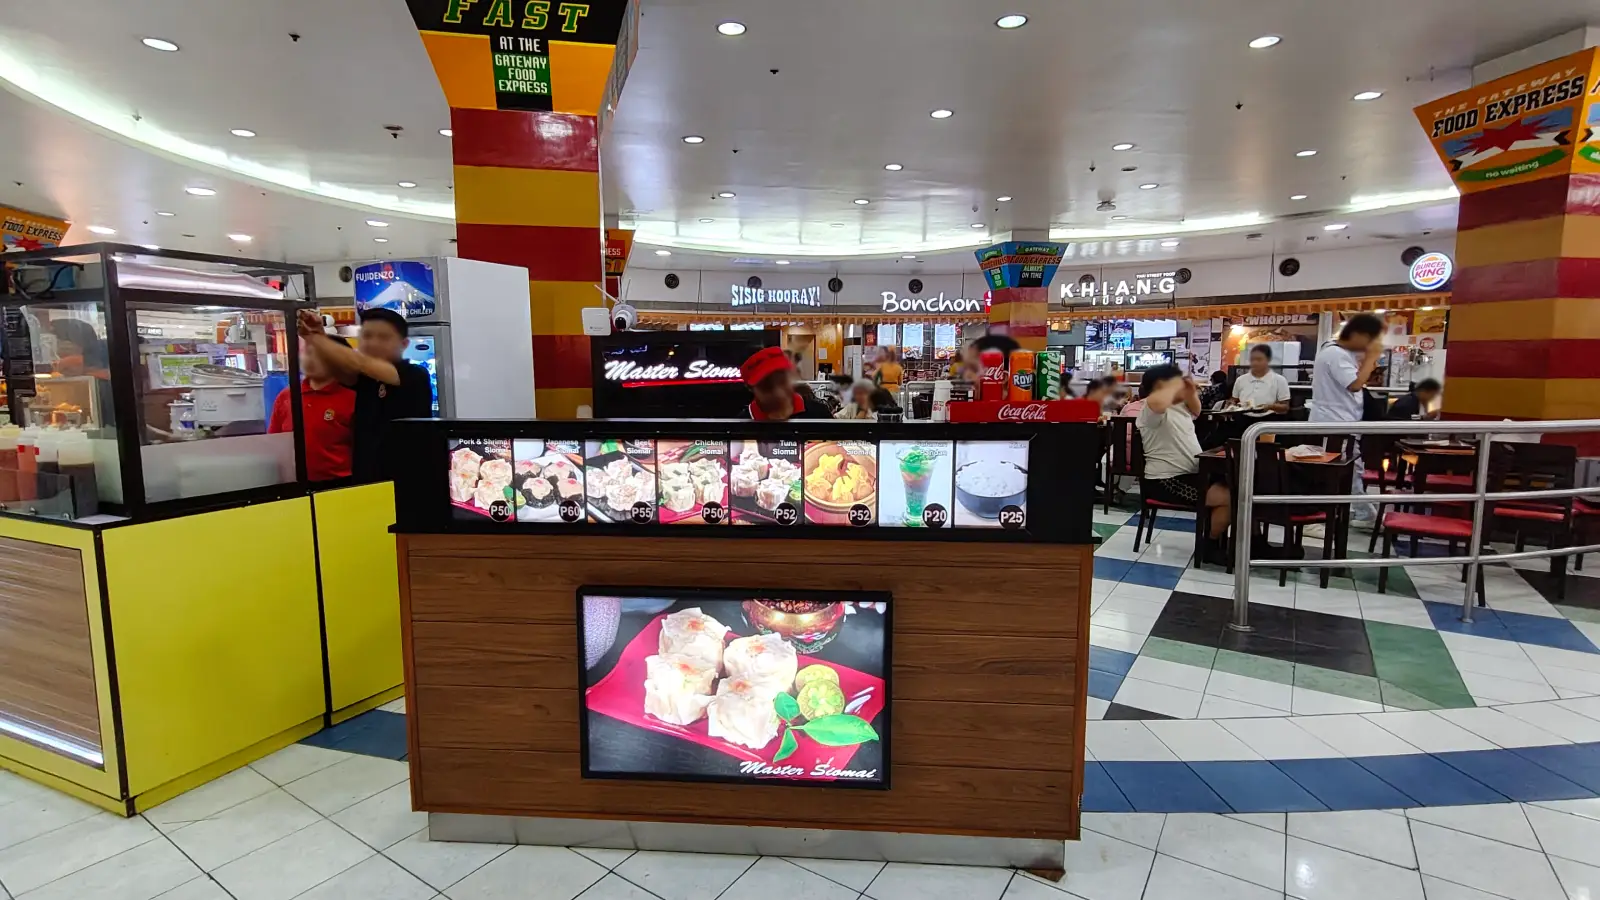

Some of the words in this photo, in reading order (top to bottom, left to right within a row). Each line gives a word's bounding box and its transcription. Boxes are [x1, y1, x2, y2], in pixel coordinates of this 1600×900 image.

[443, 0, 589, 33] FAST
[500, 36, 514, 50] AT
[519, 37, 541, 53] THE
[495, 54, 547, 70] GATEWAY
[508, 67, 537, 81] FOOD
[498, 80, 548, 94] EXPRESS
[1433, 101, 1468, 119] THE
[1477, 67, 1577, 105] GATEWAY
[1431, 108, 1479, 139] FOOD
[1484, 74, 1586, 124] EXPRESS
[1485, 170, 1500, 179] no
[1500, 160, 1540, 177] waiting
[2, 220, 25, 233] FOOD
[26, 225, 63, 241] EXPRESS
[1029, 255, 1062, 265] EXPRESS
[1416, 261, 1447, 271] BURGER
[355, 270, 395, 282] FUJIDENZO
[1414, 268, 1446, 279] KING
[731, 284, 765, 307] SISIG
[767, 285, 821, 307] HOORAY!
[880, 290, 982, 313] Bonchon
[410, 307, 433, 316] CHILLER
[1245, 314, 1308, 325] WHOPPER
[604, 359, 679, 380] Master
[997, 403, 1048, 420] Coca-Cola
[459, 438, 475, 446] Pork
[546, 439, 579, 447] Japanese
[694, 439, 724, 447] Chicken
[484, 446, 509, 454] Siomai
[699, 447, 724, 455] Siomai
[490, 505, 511, 517] P50
[560, 505, 580, 517] P60
[631, 506, 651, 518] P55
[703, 507, 723, 519] P50
[775, 508, 796, 520] P52
[850, 510, 870, 521] P52
[924, 510, 947, 522] P20
[1001, 511, 1024, 523] P25
[740, 760, 805, 776] Master
[810, 762, 877, 778] Siomai
